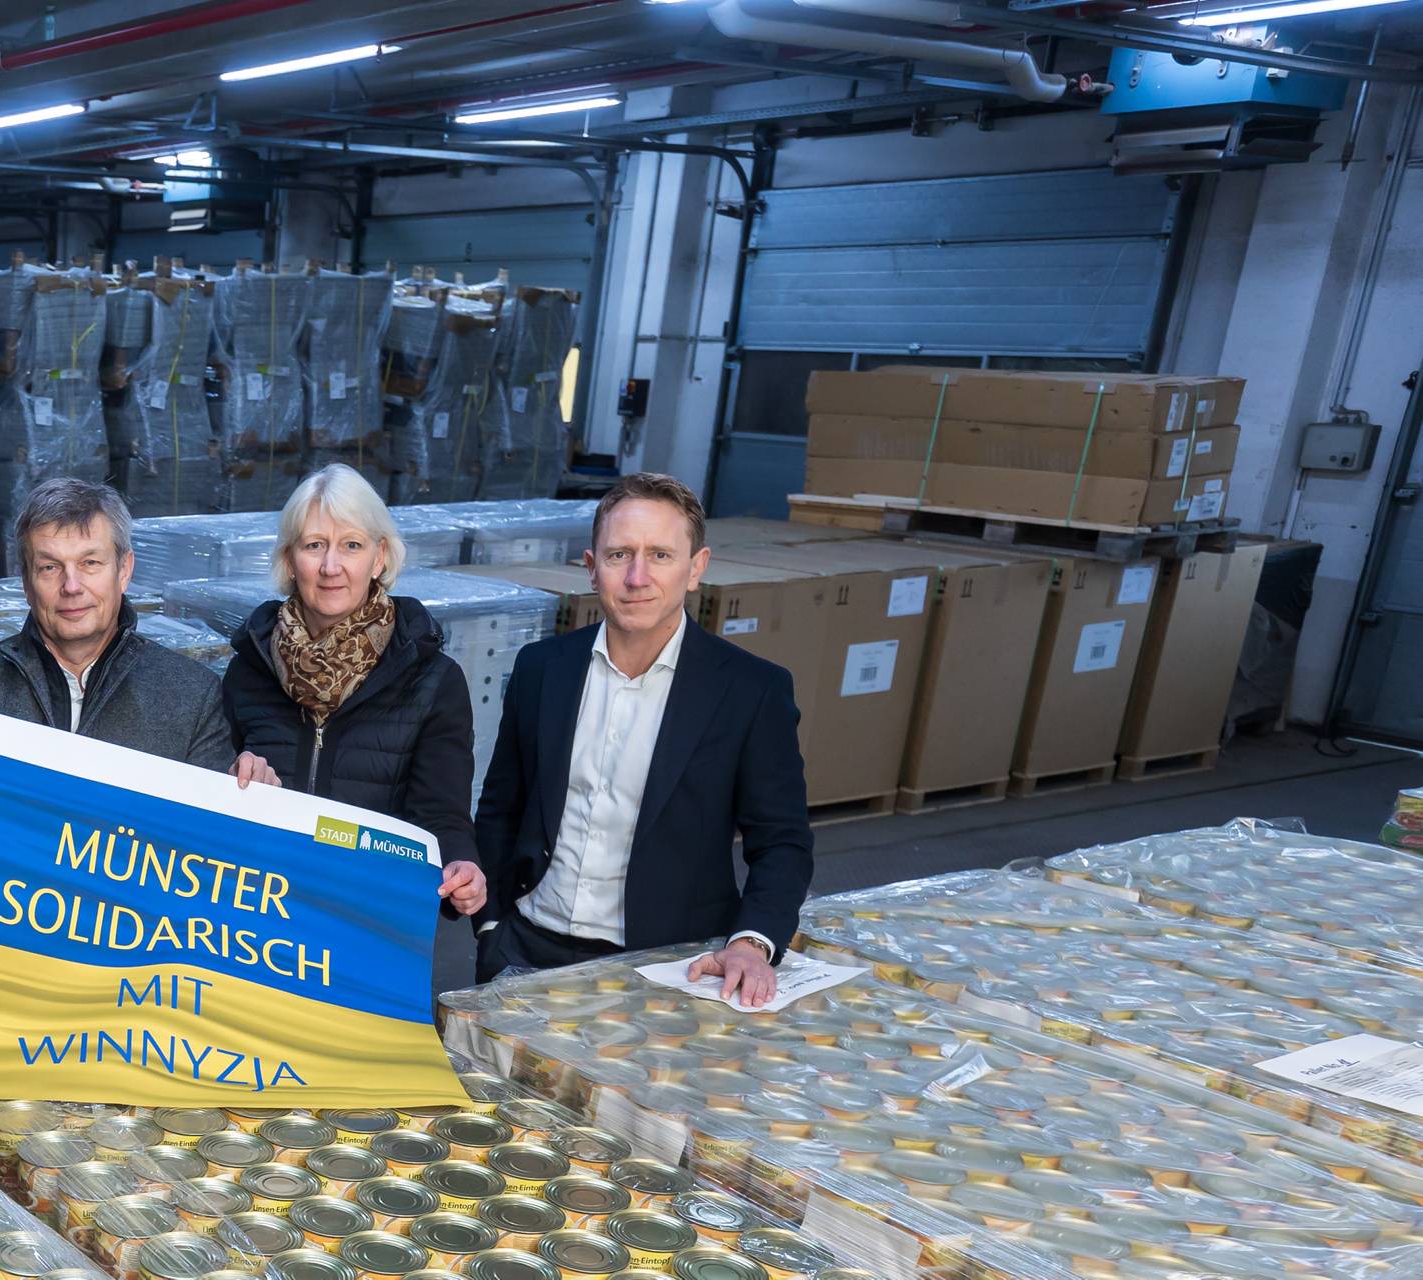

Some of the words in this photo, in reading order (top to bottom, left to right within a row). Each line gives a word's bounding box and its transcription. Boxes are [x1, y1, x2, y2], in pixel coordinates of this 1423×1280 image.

[55, 822, 290, 919] MÜNSTER
[319, 827, 355, 844] STADT
[373, 840, 424, 862] MÜNSTER
[117, 975, 213, 1016] MIT
[18, 1029, 307, 1092] WINNYZJA
